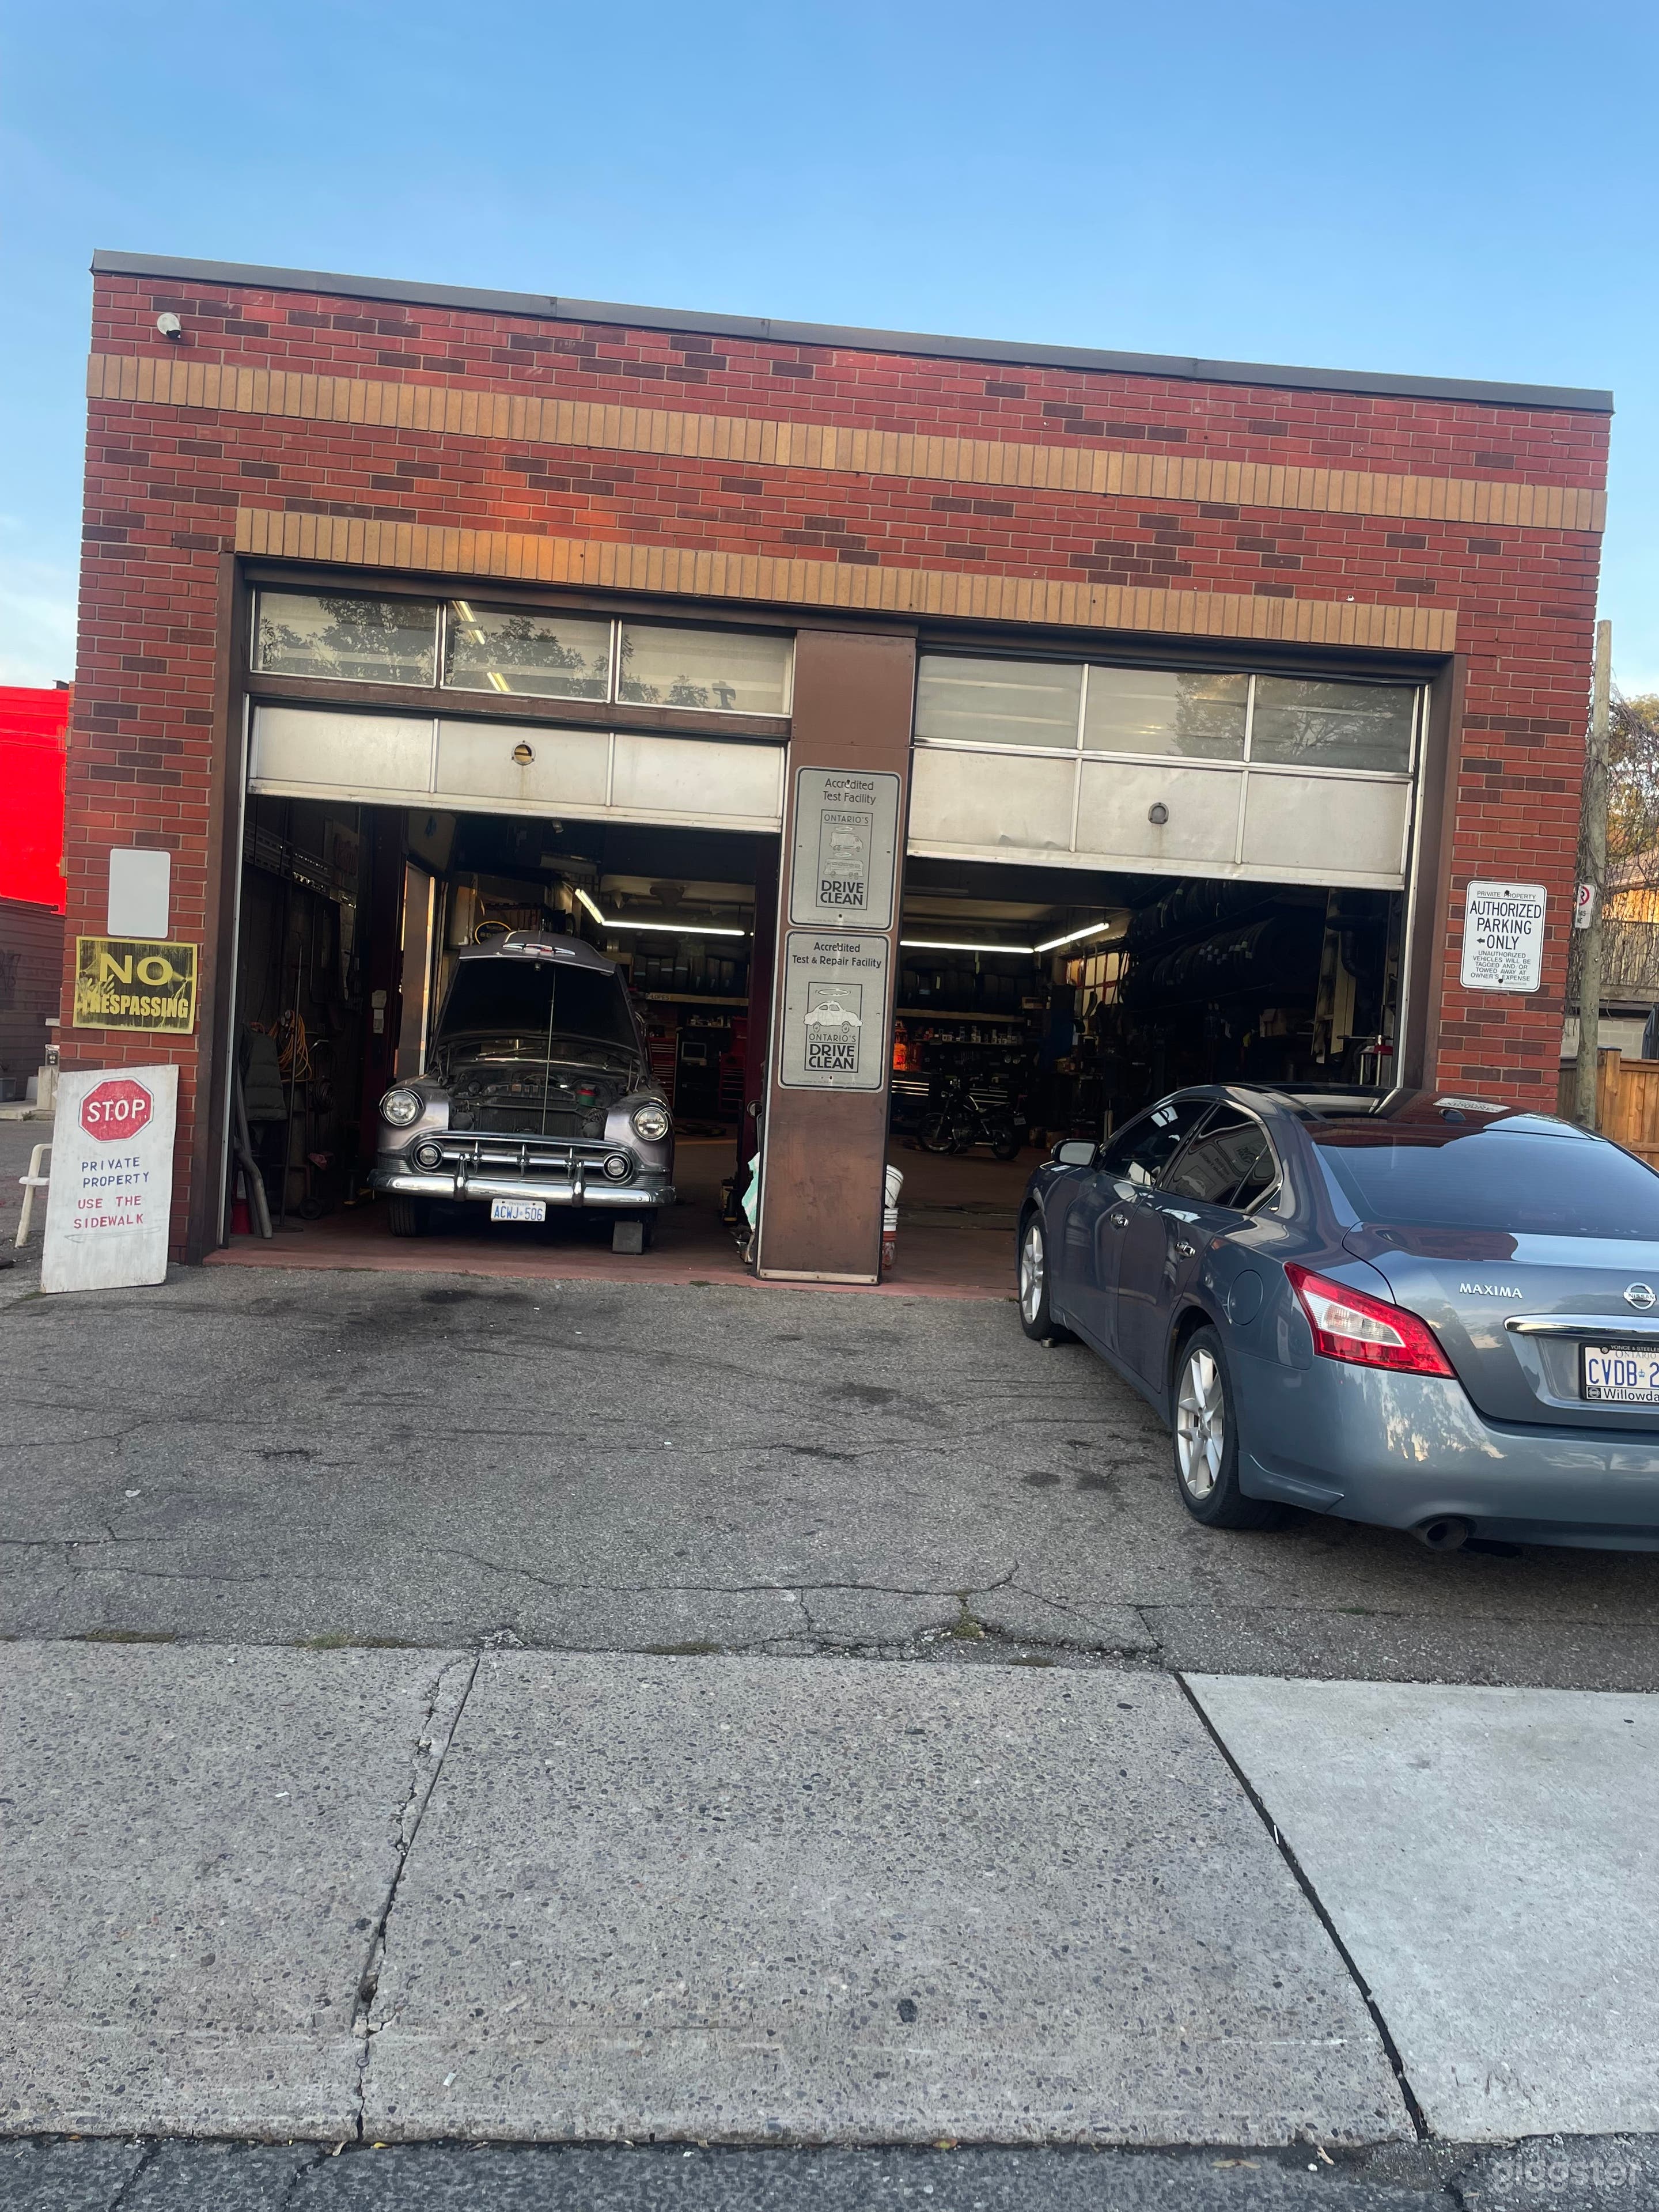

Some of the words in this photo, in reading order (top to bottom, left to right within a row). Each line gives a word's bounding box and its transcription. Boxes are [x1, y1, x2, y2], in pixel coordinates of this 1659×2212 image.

[824, 778, 874, 790] Accredited
[823, 791, 841, 801] Test
[844, 793, 876, 805] Facility
[824, 815, 869, 824] ONTARIO'S
[821, 880, 864, 893] DRIVE
[820, 892, 863, 906] CLEAN
[1469, 900, 1541, 918] AUTHORIZED
[1477, 918, 1532, 934] PARKING
[814, 942, 860, 952] Accredited
[1487, 935, 1519, 950] ONLY
[792, 955, 809, 964] Test
[820, 956, 849, 967] Repair
[852, 957, 881, 969] Facility
[100, 953, 173, 986] NO
[809, 1033, 856, 1043] ONTARIO'S
[810, 1044, 855, 1057] DRIVE
[808, 1056, 854, 1069] CLEAN
[87, 1099, 145, 1122] STOP
[82, 1157, 140, 1172] PRIVATE
[83, 1172, 149, 1188] PROPERTY
[78, 1198, 103, 1209] USE
[116, 1195, 142, 1207] THE
[74, 1213, 143, 1229] SIDEWALK
[1460, 1283, 1523, 1298] MAXIMA
